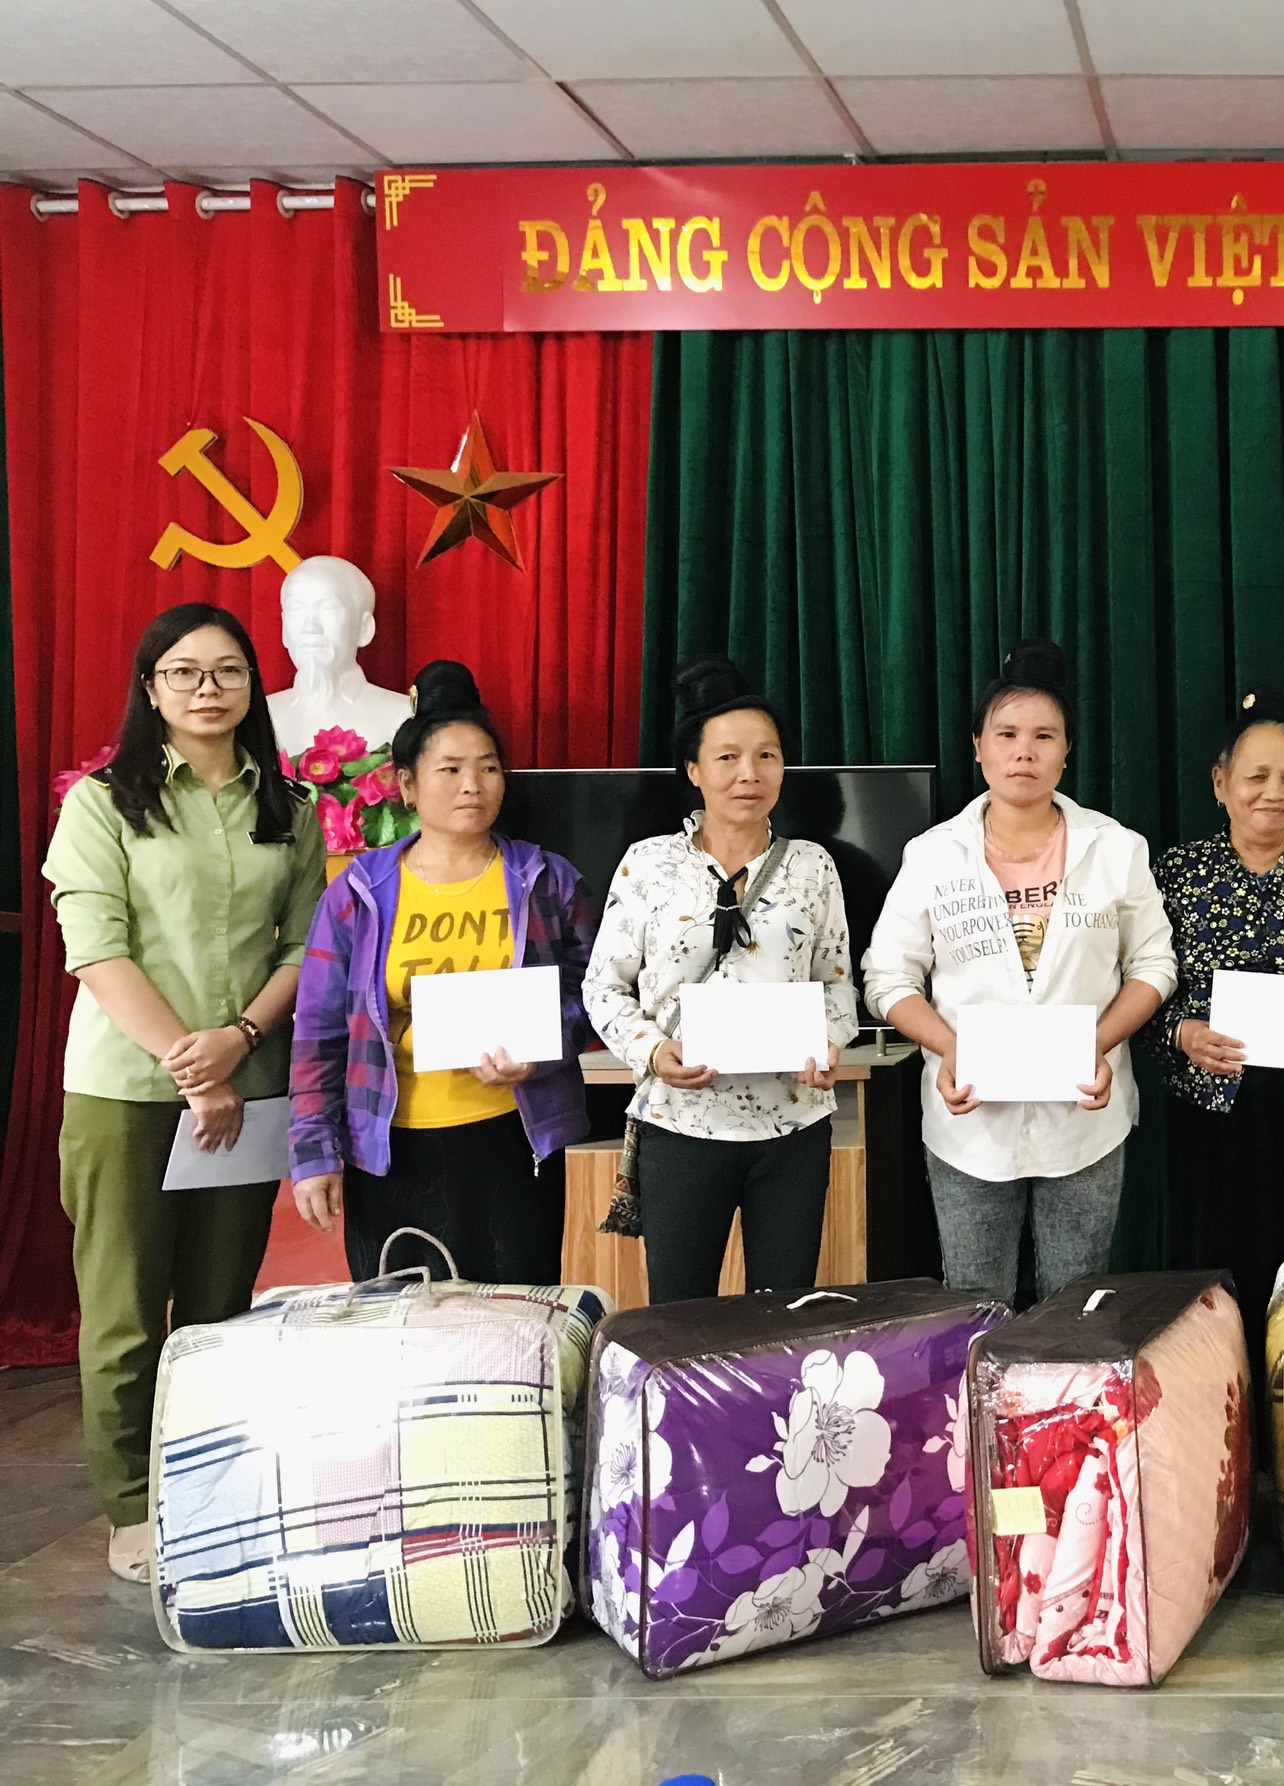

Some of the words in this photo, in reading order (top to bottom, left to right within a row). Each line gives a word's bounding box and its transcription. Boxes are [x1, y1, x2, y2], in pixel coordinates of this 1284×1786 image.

[518, 183, 728, 293] ĐẢNG
[747, 191, 948, 304] CỘNG
[967, 178, 1114, 289] SẢN
[934, 878, 976, 900] NEVER
[1005, 879, 1062, 903] BER
[402, 908, 511, 948] DONT
[1063, 912, 1081, 927] TO
